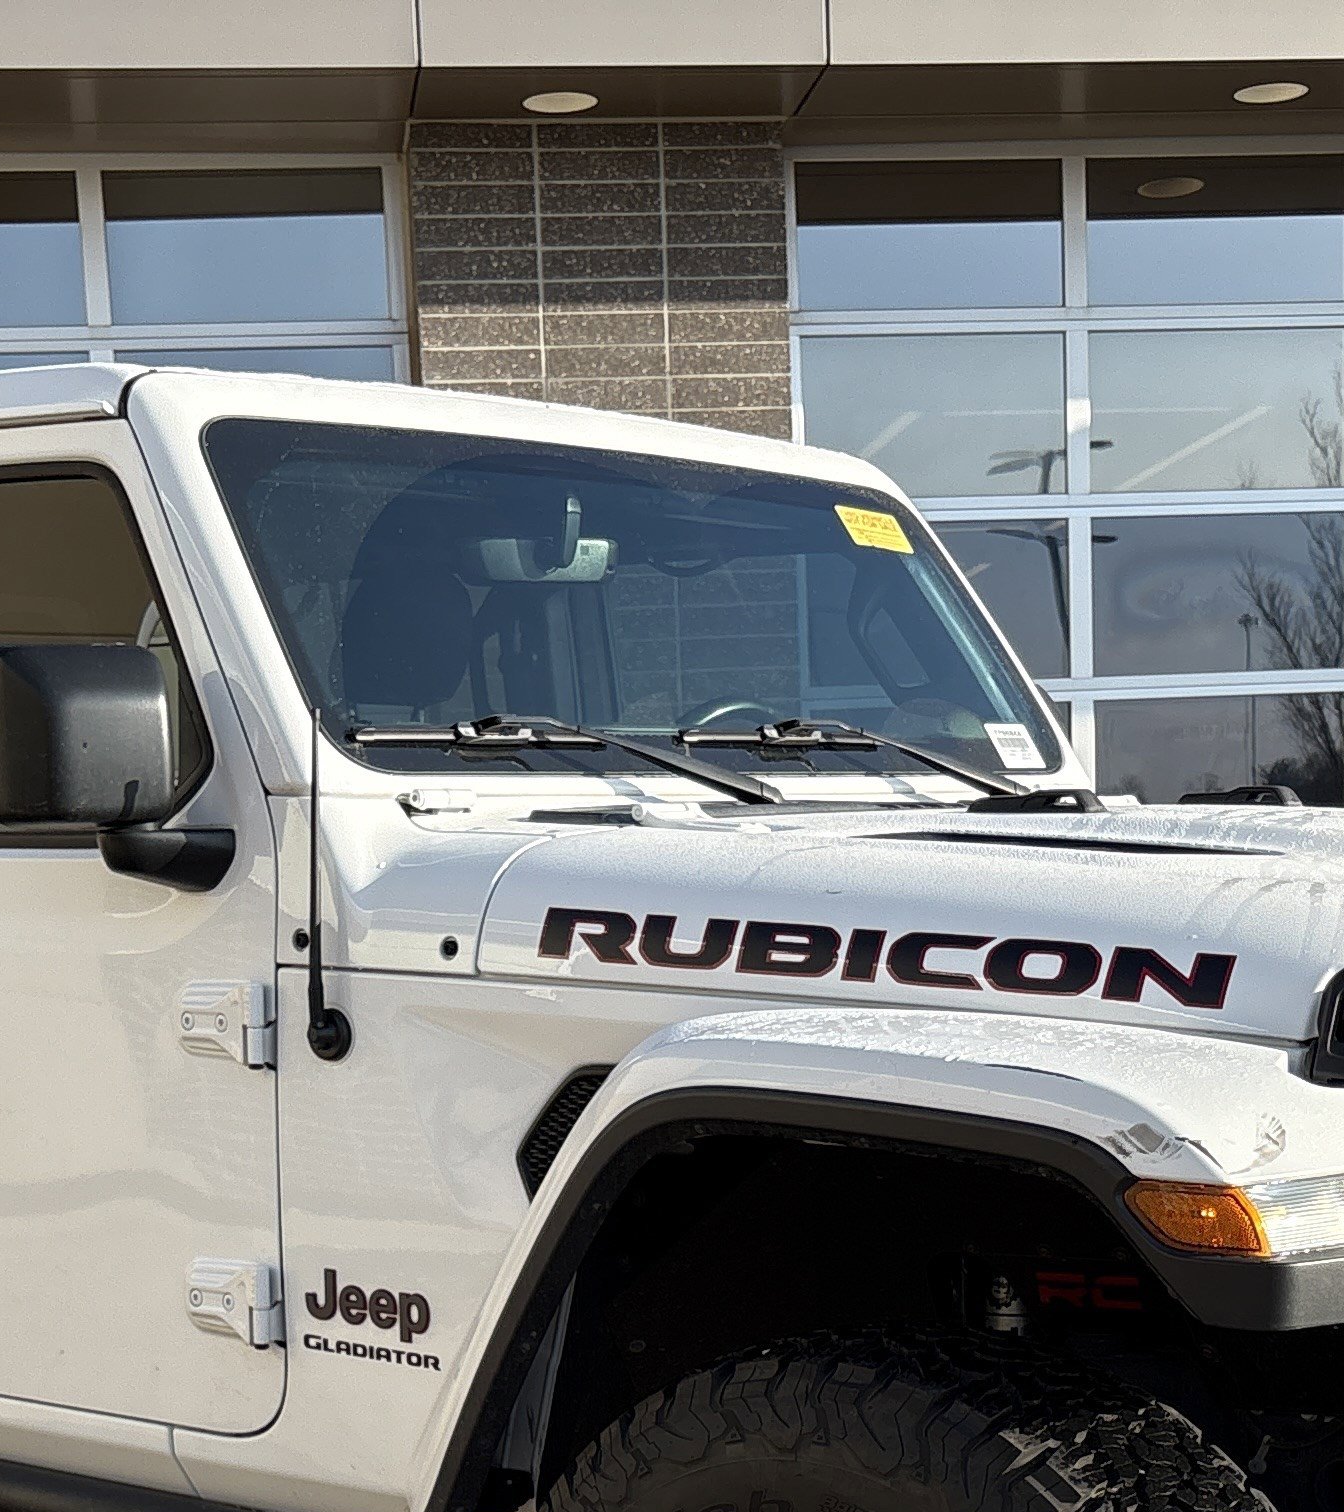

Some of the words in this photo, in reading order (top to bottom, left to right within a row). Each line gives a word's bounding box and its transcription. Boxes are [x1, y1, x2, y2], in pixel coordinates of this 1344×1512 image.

[538, 906, 1237, 1009] RUBICON
[305, 1267, 430, 1343] Jeep
[303, 1333, 442, 1371] GLADIATOR
